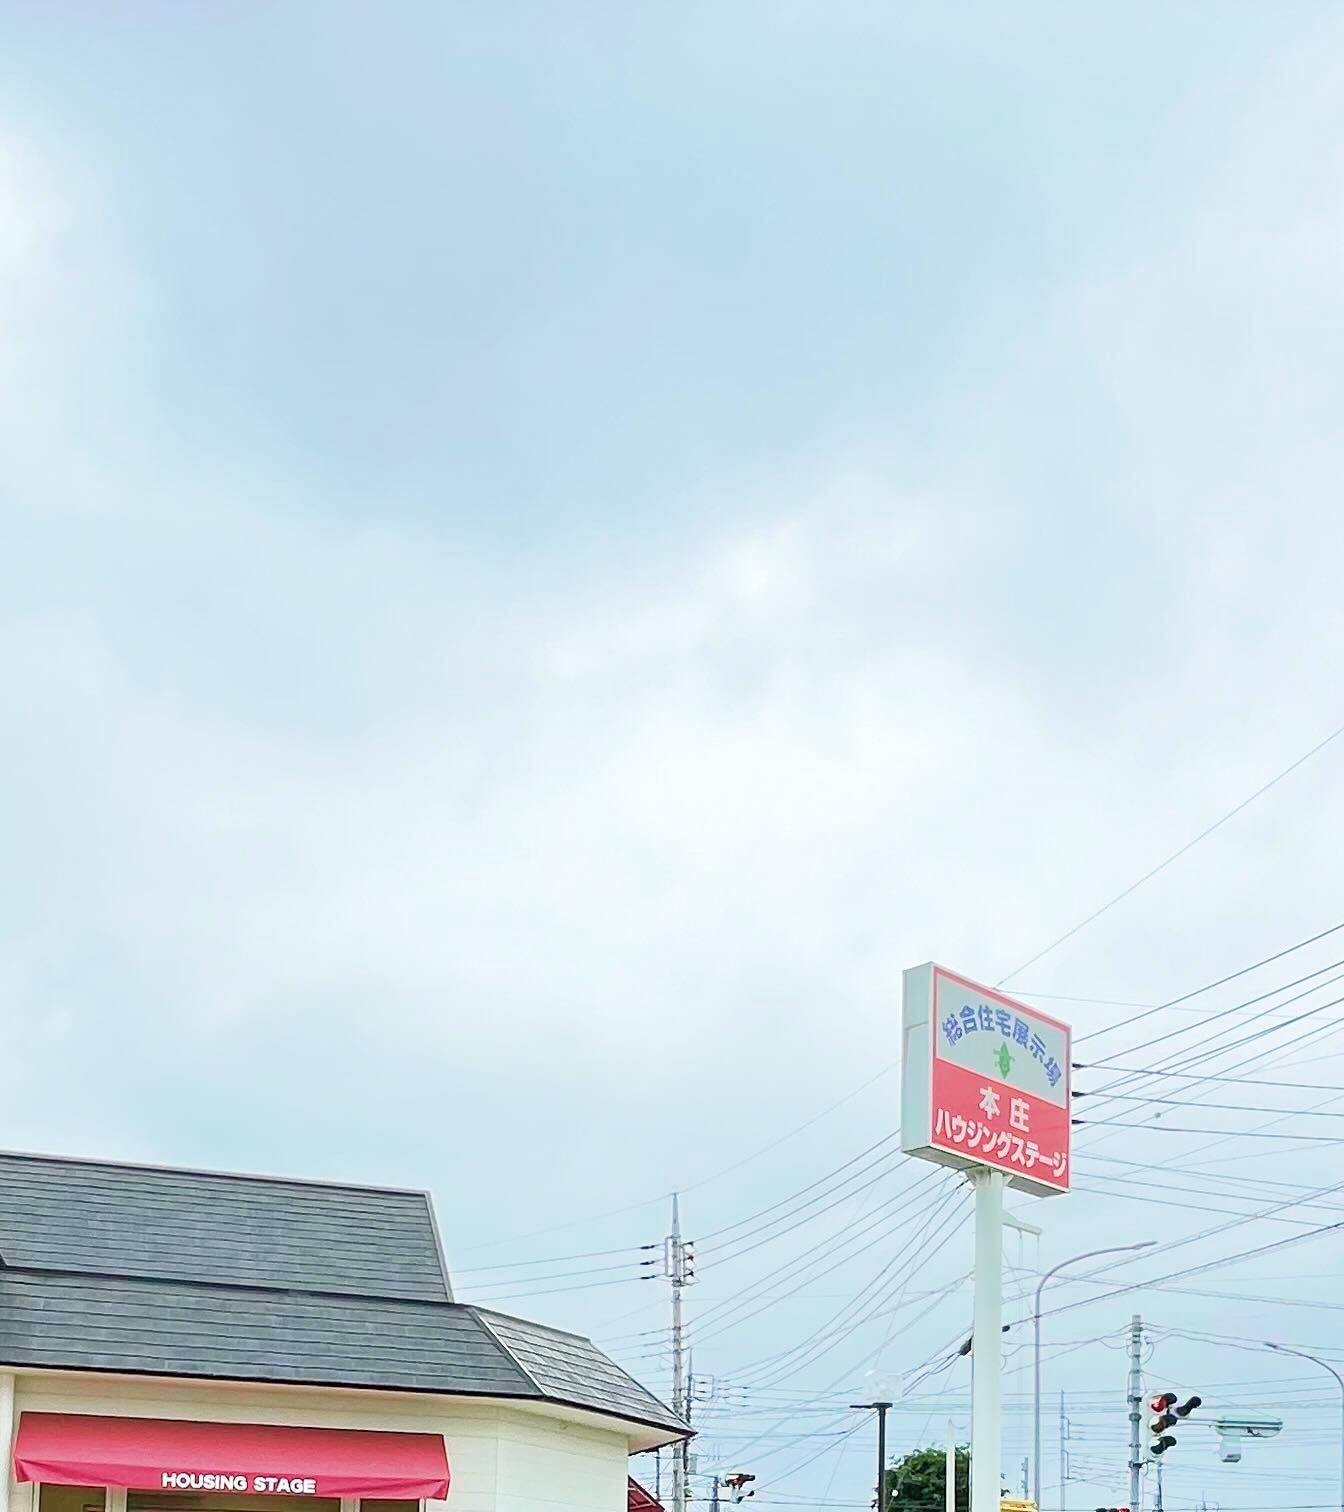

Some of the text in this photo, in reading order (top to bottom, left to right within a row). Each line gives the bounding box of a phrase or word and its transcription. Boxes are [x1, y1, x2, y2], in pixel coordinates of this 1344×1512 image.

[942, 1004, 1062, 1088] 総合住宅展示場
[979, 1086, 1030, 1133] 本庄
[935, 1108, 1067, 1177] ハウジングステージ
[161, 1472, 317, 1494] HOUSING STAGE
